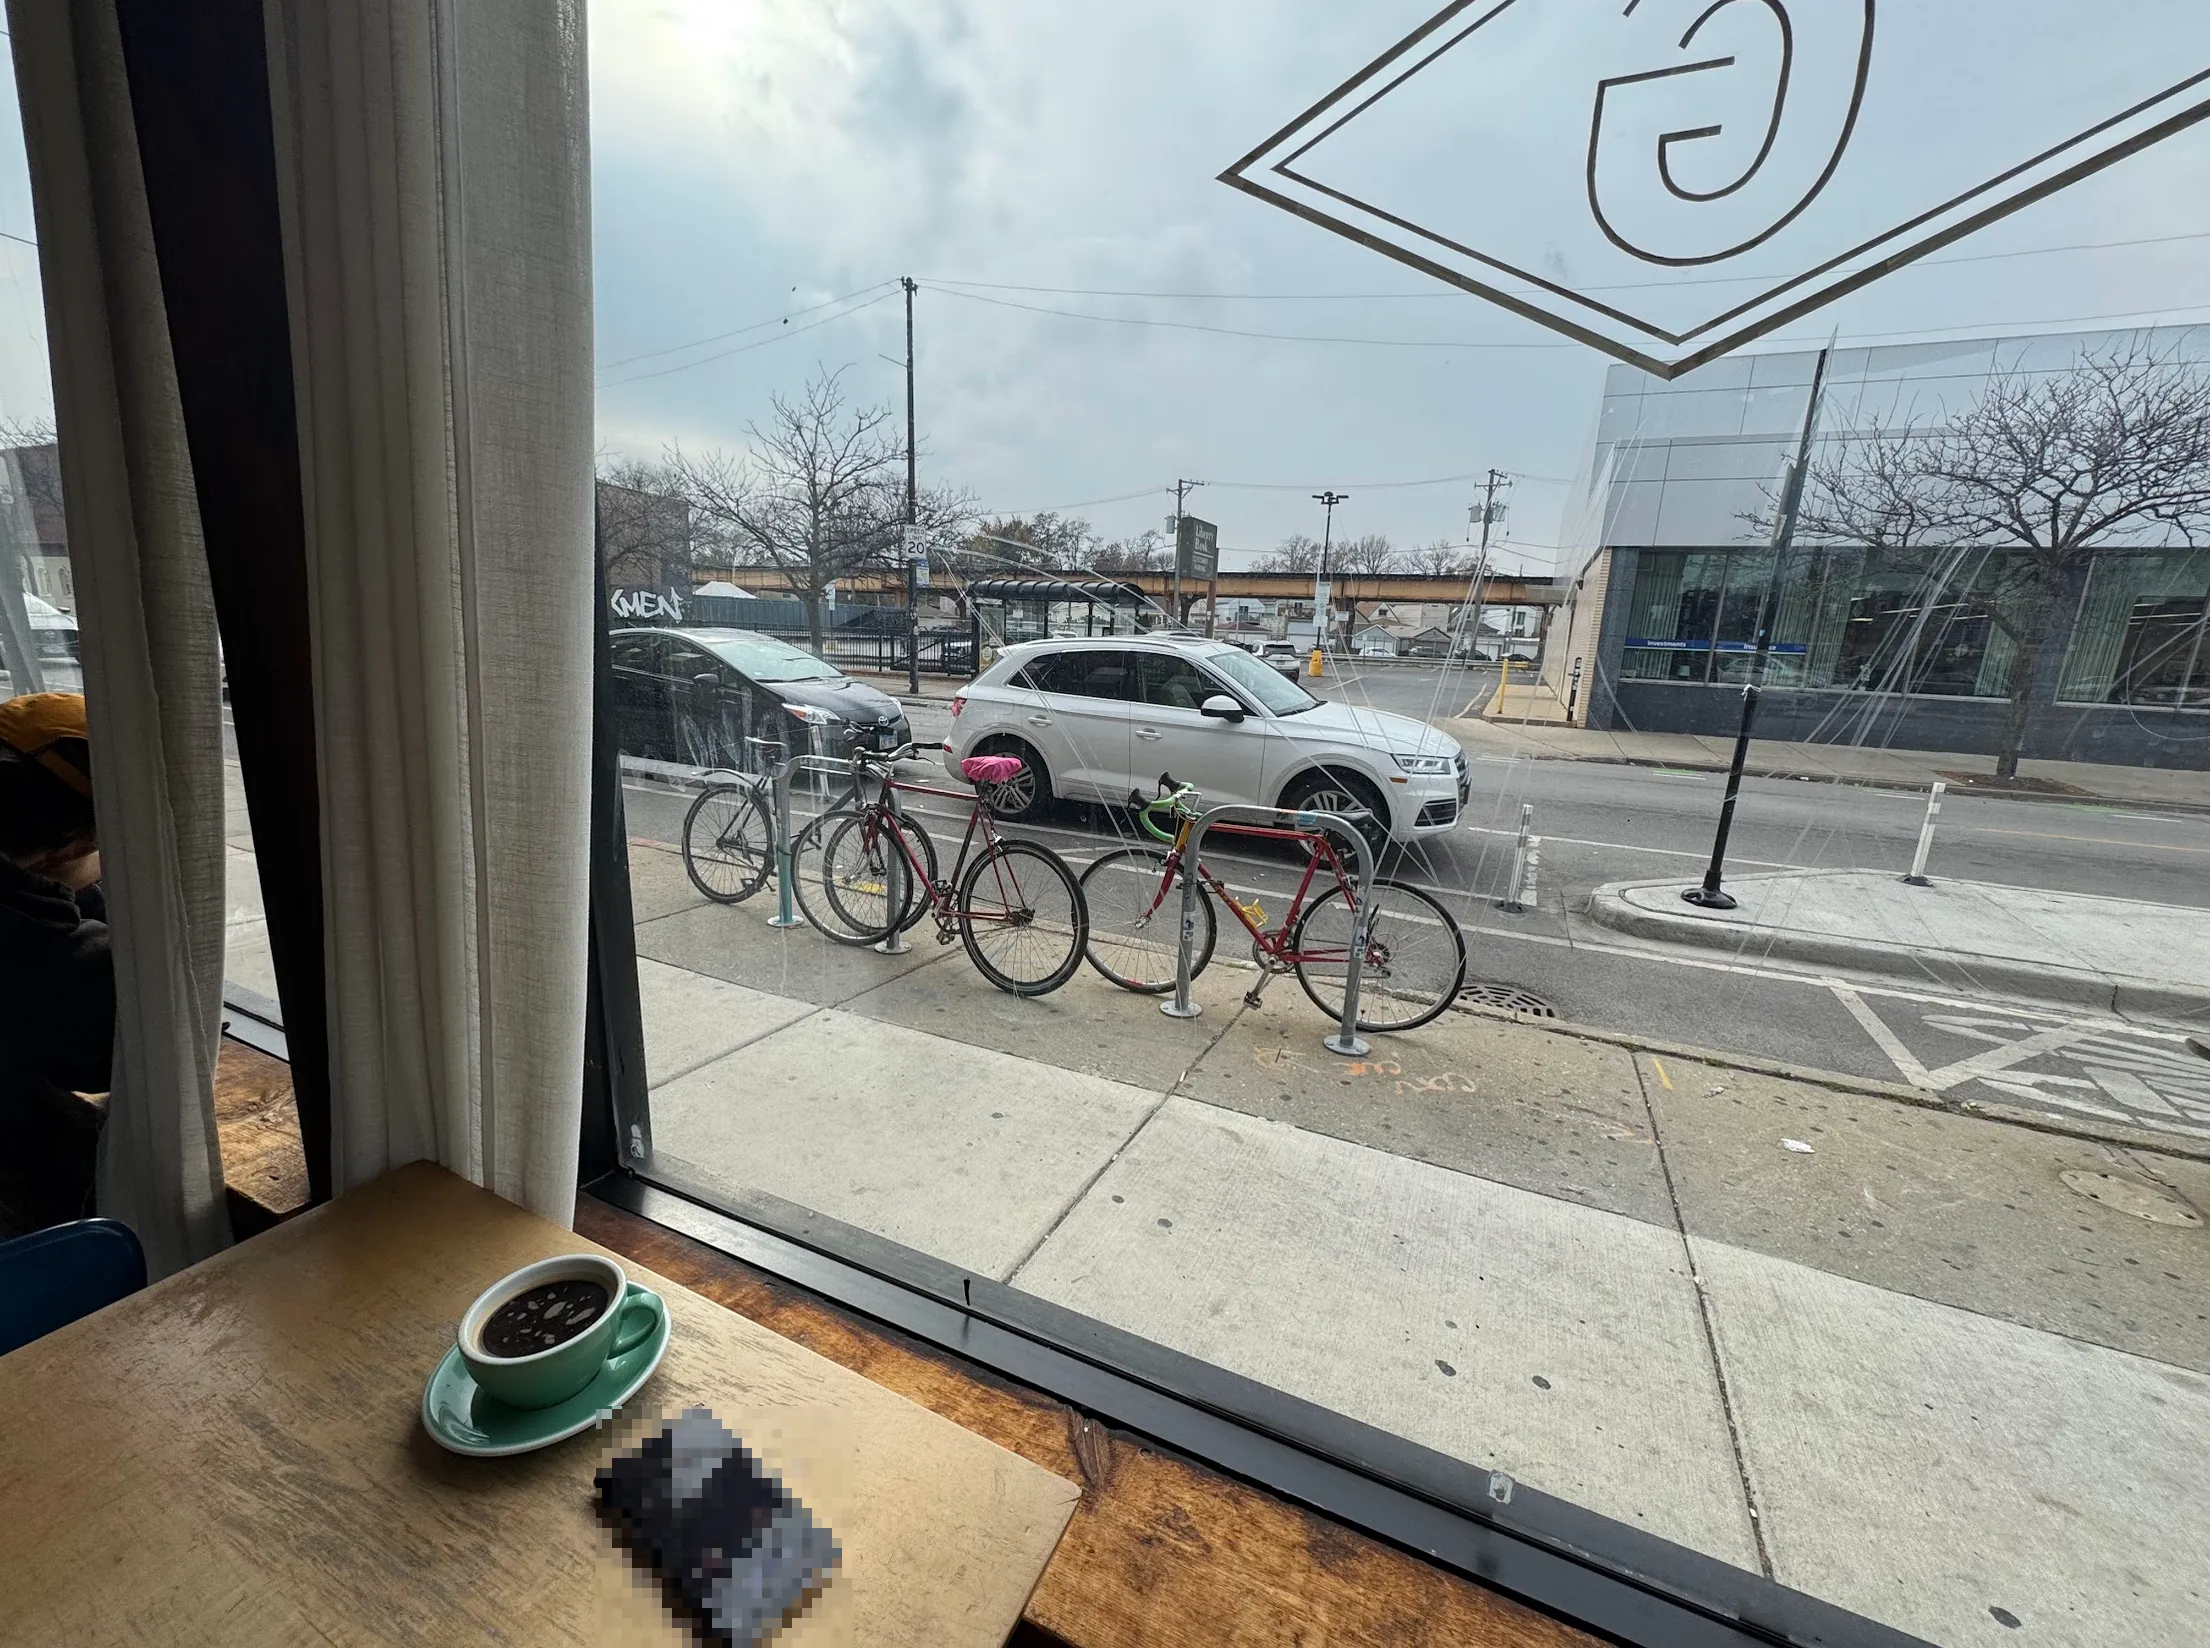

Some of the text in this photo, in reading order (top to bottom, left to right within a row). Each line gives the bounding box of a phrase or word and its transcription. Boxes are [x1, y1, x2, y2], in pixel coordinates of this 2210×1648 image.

[906, 527, 925, 535] SPEED
[907, 541, 925, 554] 20
[1647, 640, 1686, 648] Investments
[1743, 643, 1777, 651] Insuce
